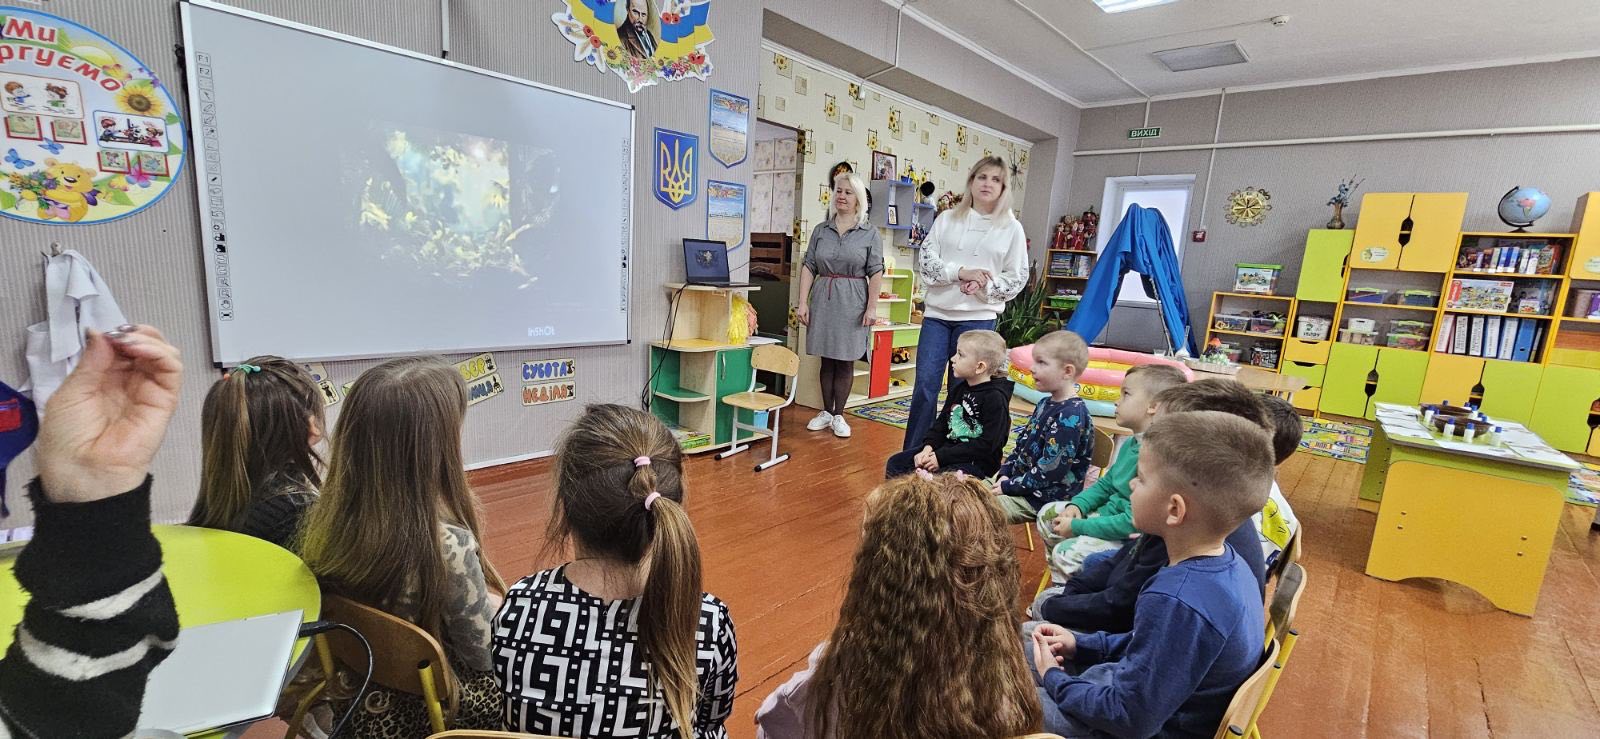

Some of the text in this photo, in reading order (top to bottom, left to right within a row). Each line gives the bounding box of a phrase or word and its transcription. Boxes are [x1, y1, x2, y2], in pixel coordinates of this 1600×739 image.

[0, 44, 121, 91] ргуємо
[1131, 129, 1157, 137] ВИХІД
[460, 358, 486, 380] ВЕР
[522, 361, 567, 380] СУБОТА
[522, 384, 567, 403] НЕДІЛЯ
